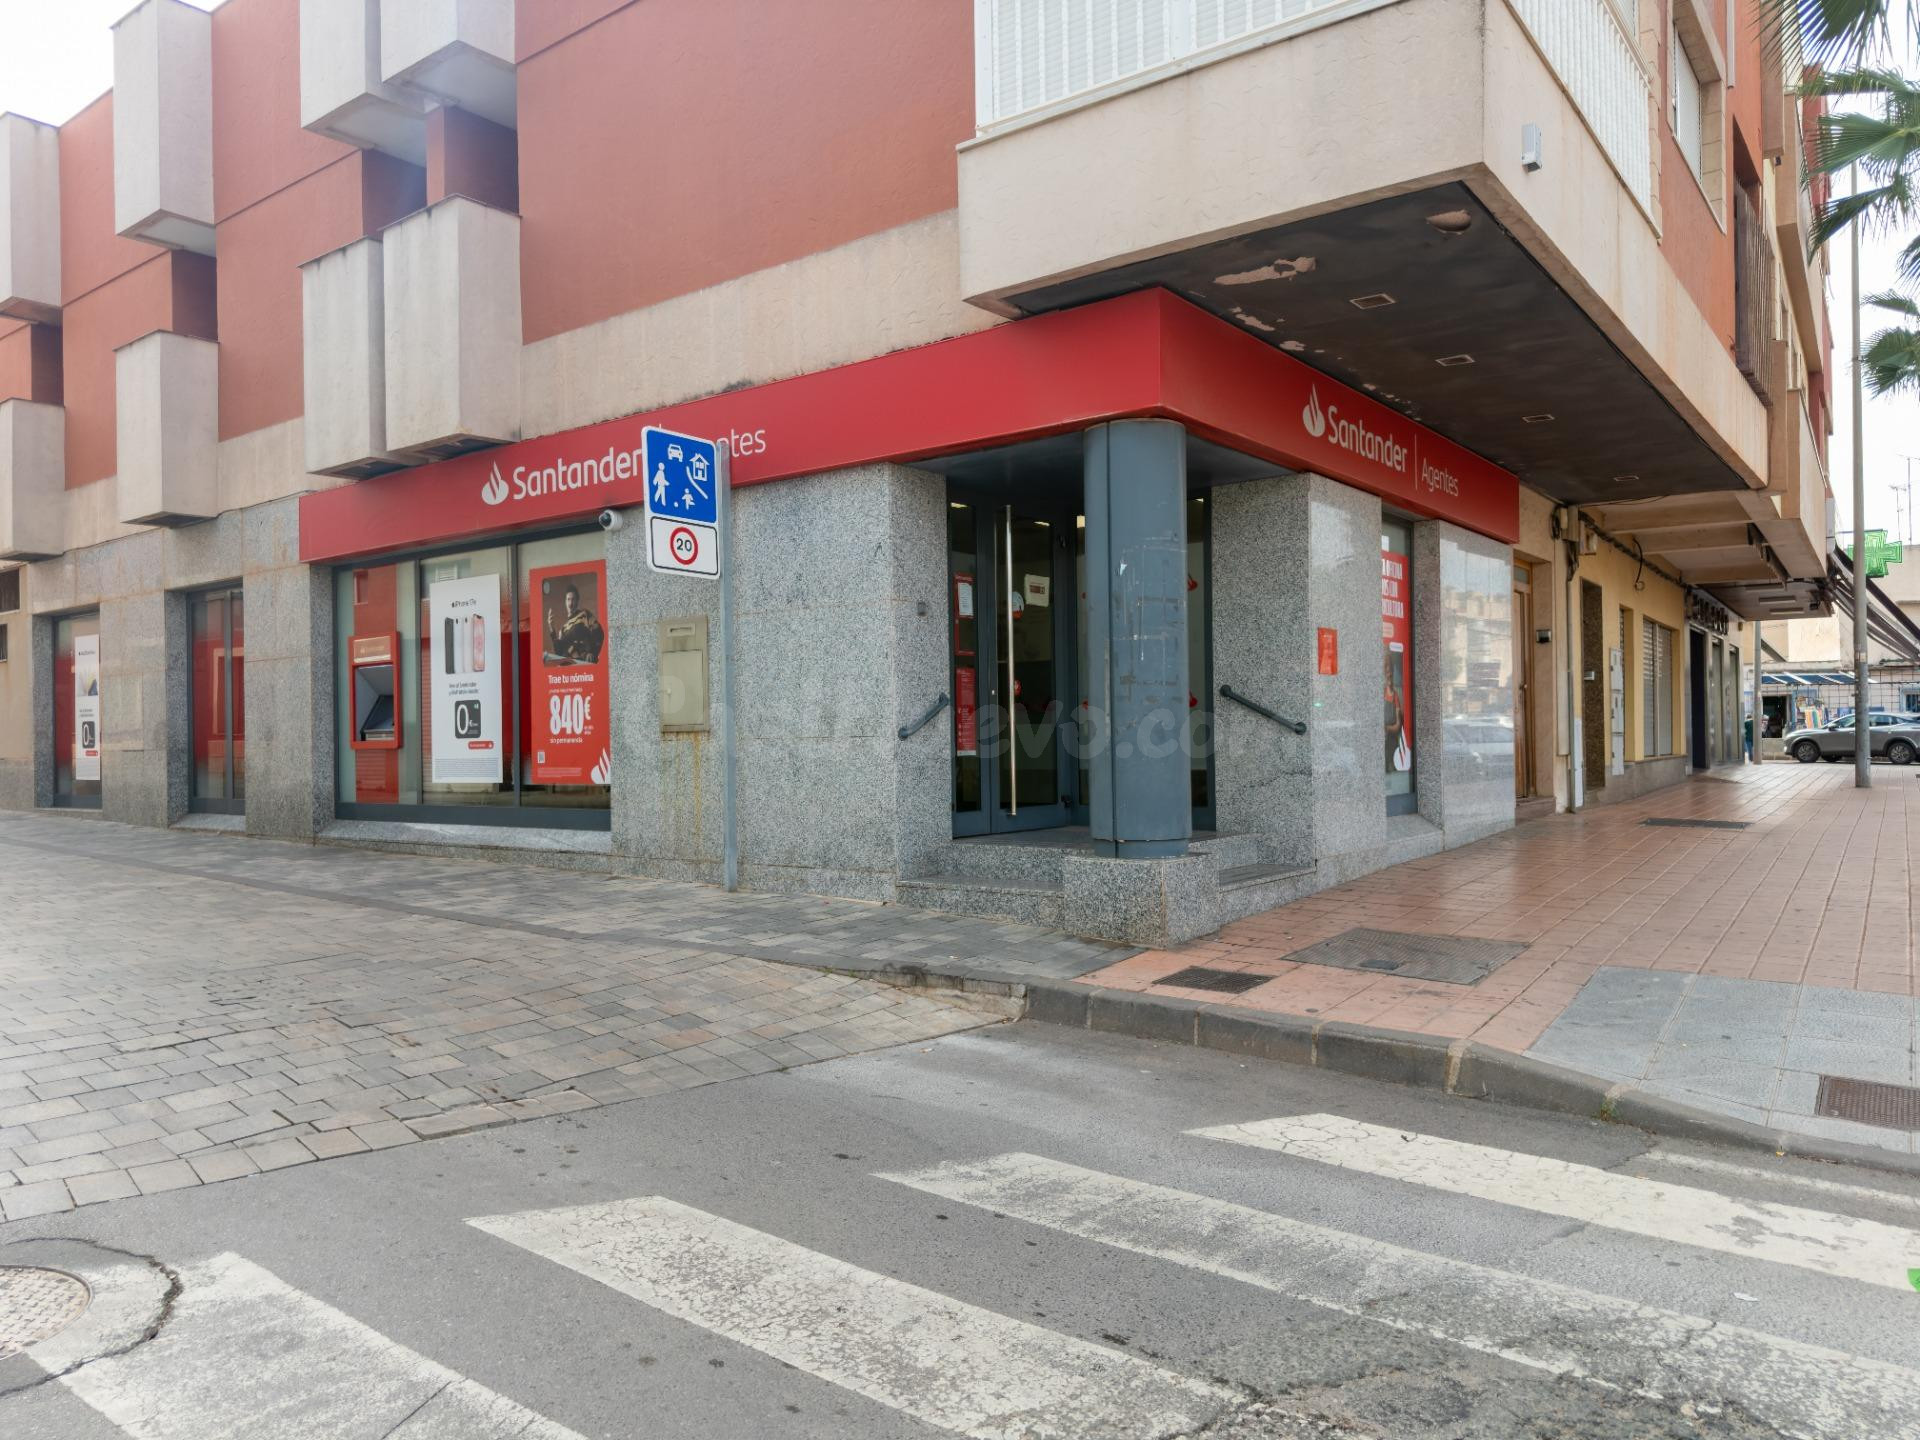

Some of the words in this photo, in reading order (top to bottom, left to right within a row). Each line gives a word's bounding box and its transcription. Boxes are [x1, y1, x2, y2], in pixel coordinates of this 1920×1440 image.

[1328, 405, 1408, 472] Santander
[1421, 457, 1459, 497] Agentes
[512, 447, 643, 500] Santander
[676, 537, 693, 552] 20
[548, 675, 562, 684] Trae
[562, 674, 570, 684] tu
[570, 672, 594, 683] nómina
